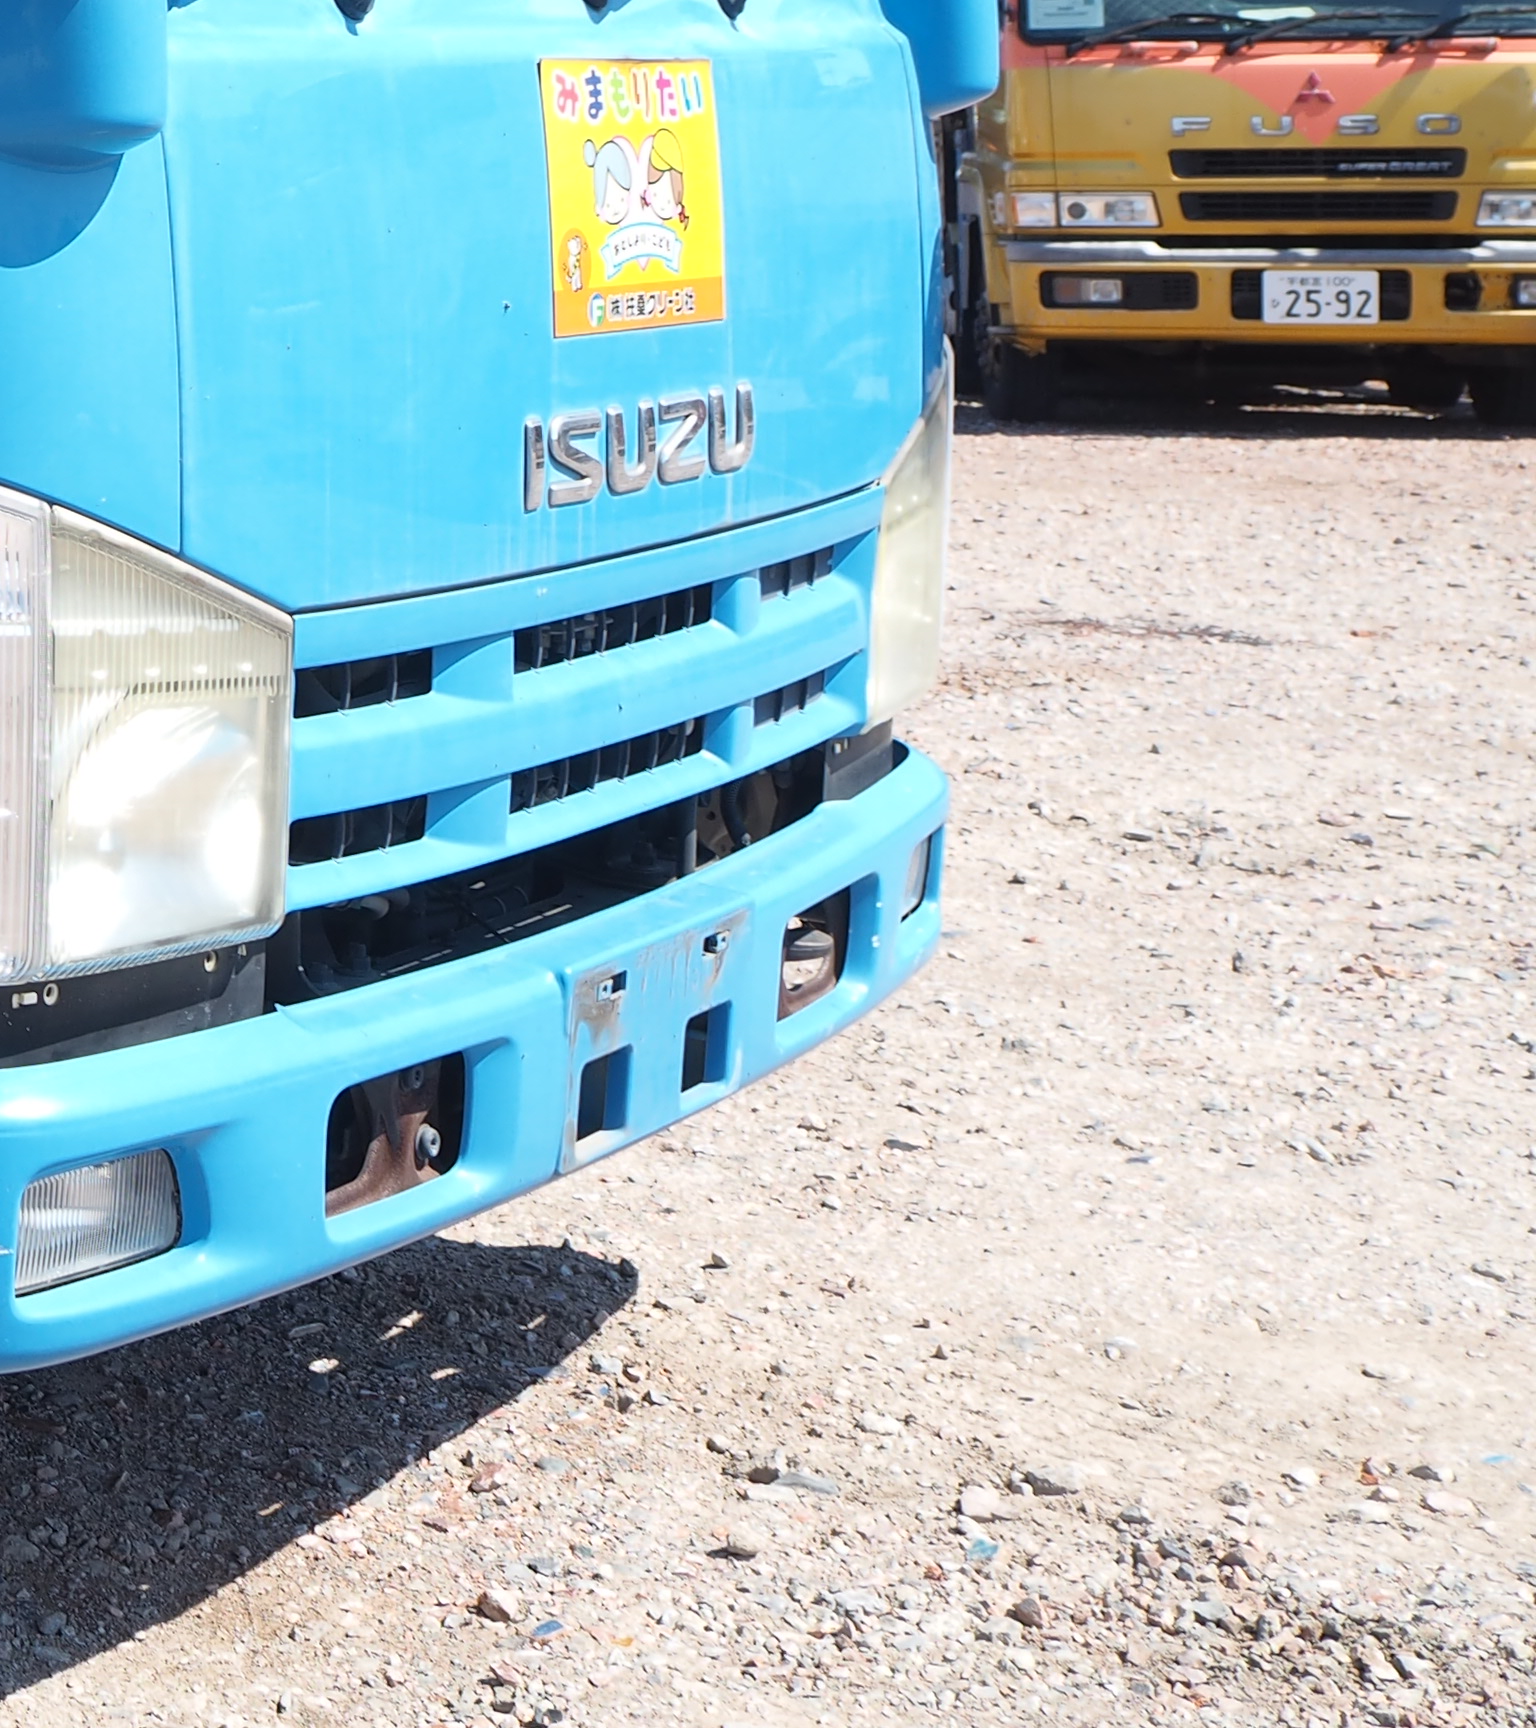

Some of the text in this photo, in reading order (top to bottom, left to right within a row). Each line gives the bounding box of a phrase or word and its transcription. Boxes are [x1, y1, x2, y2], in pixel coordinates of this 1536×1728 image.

[555, 69, 703, 119] みまもりたい
[1171, 113, 1462, 136] FUSO
[1284, 289, 1373, 318] 25-92
[523, 381, 754, 513] ISUZU
